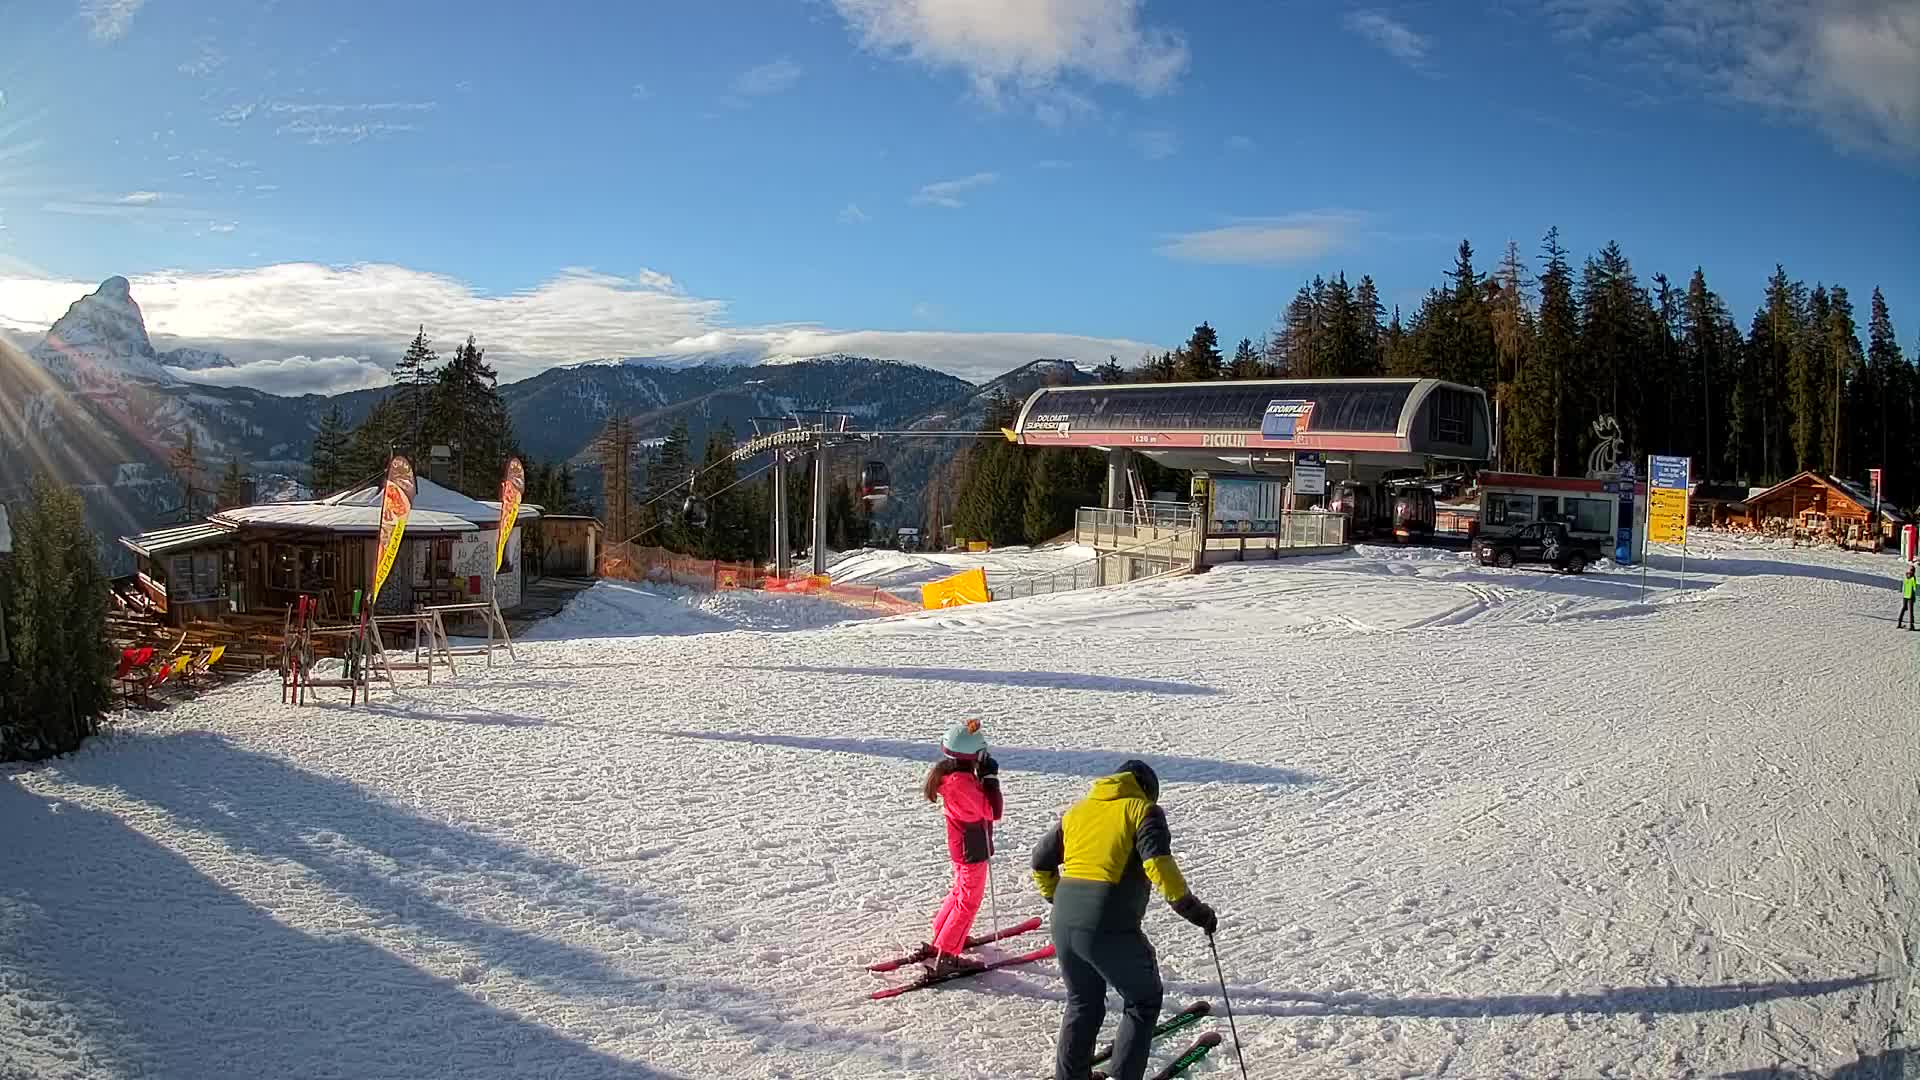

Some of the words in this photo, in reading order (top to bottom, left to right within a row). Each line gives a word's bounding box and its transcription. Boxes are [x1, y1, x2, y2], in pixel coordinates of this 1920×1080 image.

[1037, 414, 1069, 422] DOLOMITI
[1026, 422, 1058, 430] SUPERSKI
[1202, 434, 1247, 447] PICULIN
[1176, 1046, 1206, 1068] HEAD
